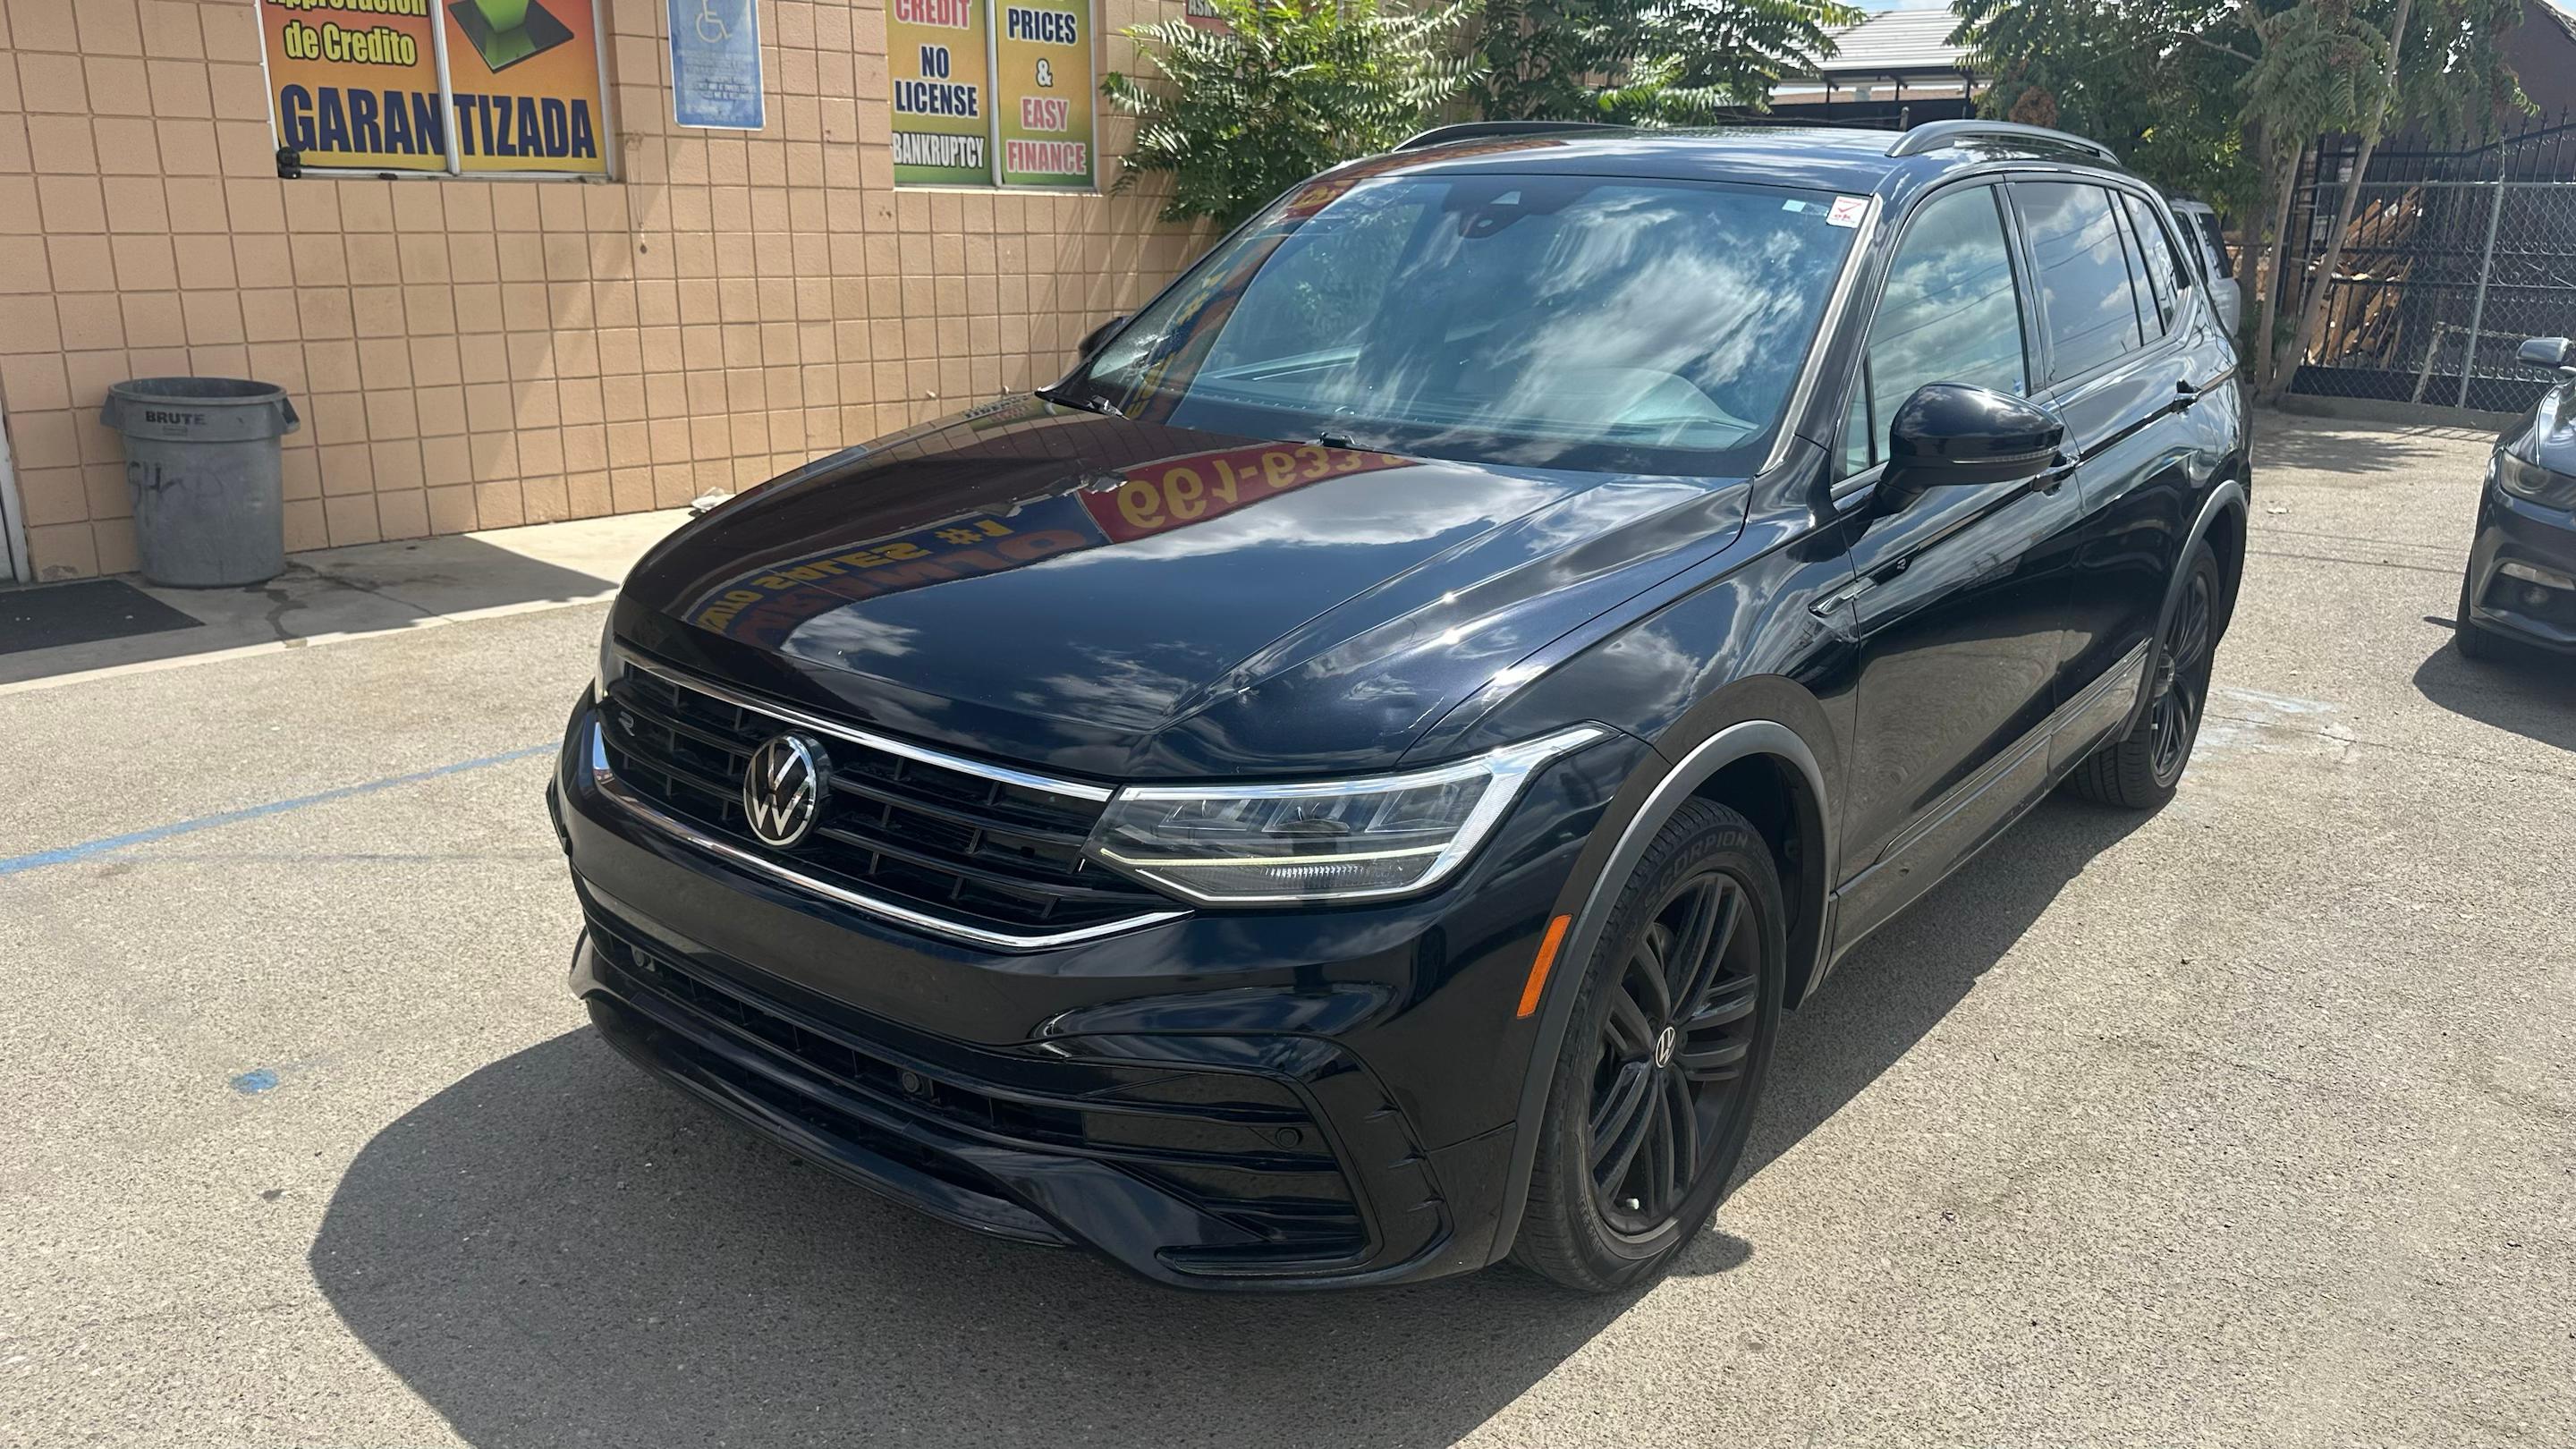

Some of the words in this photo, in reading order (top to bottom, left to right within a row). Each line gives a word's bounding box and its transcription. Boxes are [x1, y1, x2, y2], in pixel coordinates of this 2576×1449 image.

[894, 0, 970, 28] CREDIT
[1007, 7, 1077, 45] PRICES
[284, 20, 319, 60] de
[321, 21, 418, 66] Credito
[920, 46, 951, 80] NO
[1036, 58, 1053, 88] &
[894, 80, 979, 117] LICENSE
[1021, 97, 1069, 131] EASY
[279, 83, 598, 159] GARANTIZADA
[892, 131, 985, 169] BANKRUPTCY
[1007, 140, 1086, 174] FINANCE
[146, 410, 208, 426] BRUTE
